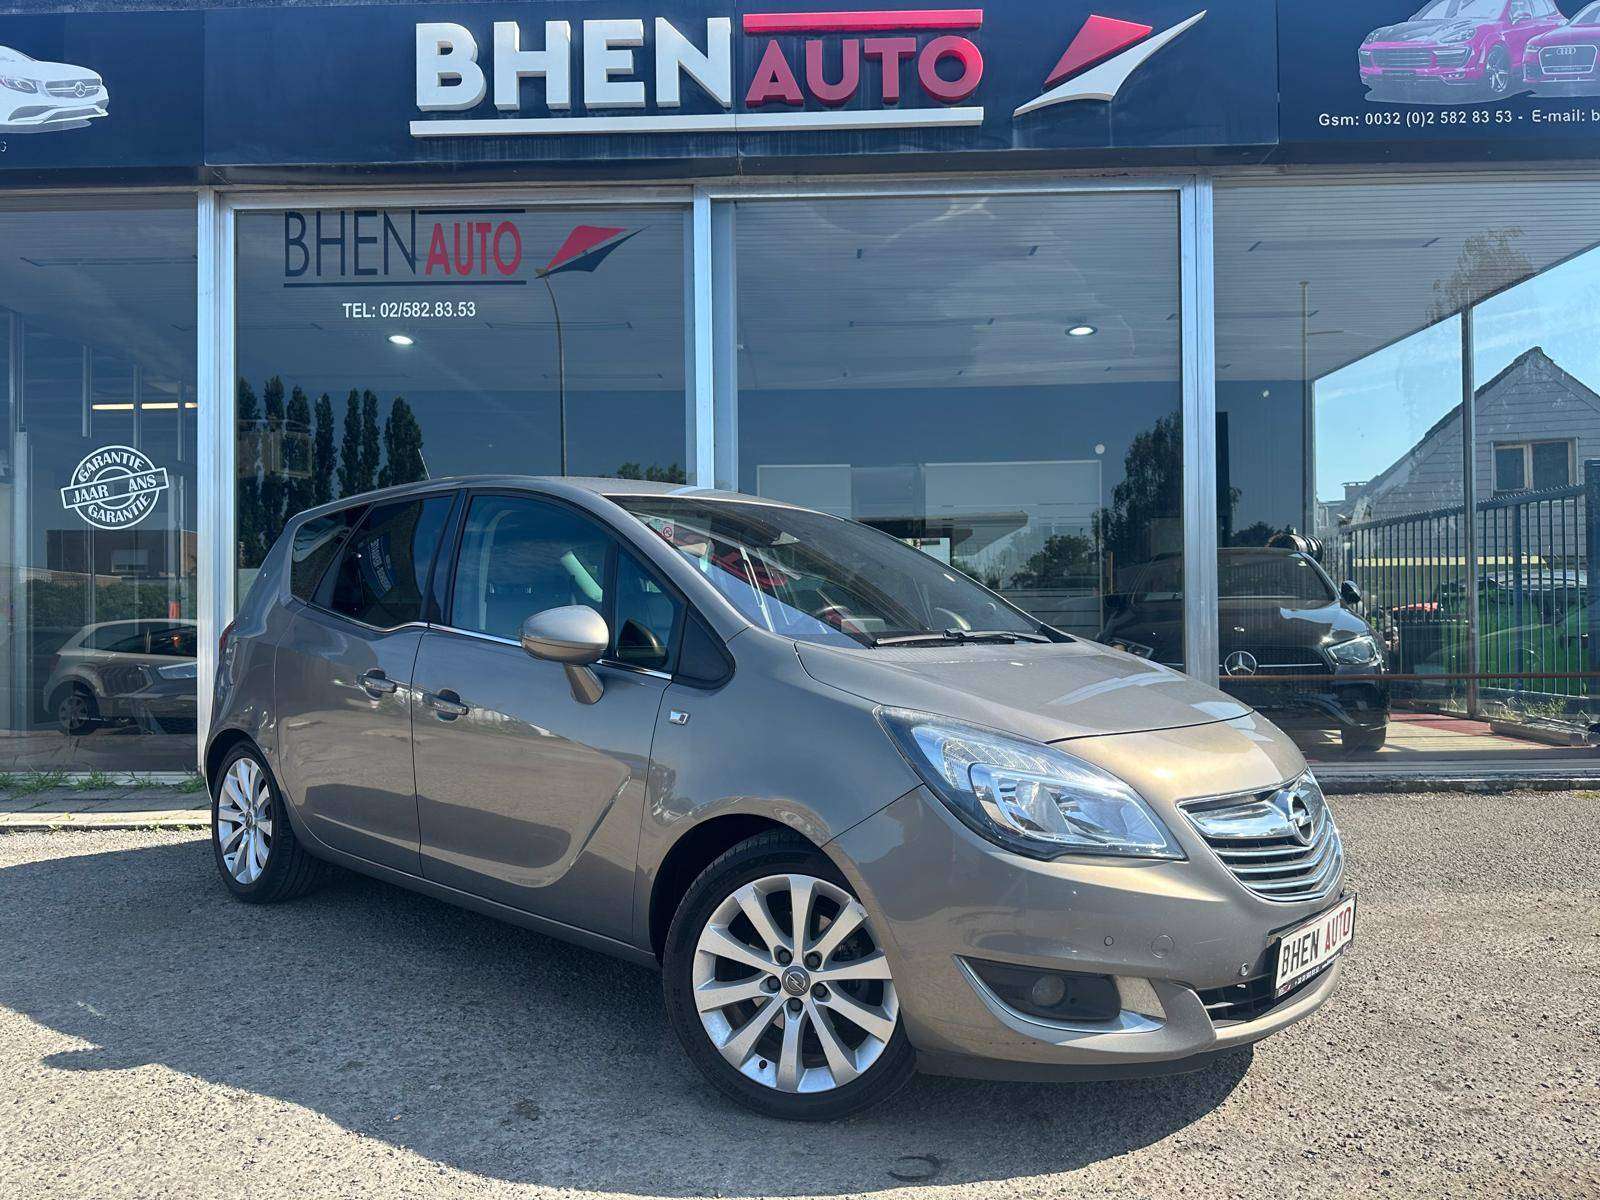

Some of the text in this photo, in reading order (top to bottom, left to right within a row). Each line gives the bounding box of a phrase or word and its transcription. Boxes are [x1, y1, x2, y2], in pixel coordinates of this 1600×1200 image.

[415, 16, 984, 112] BHEN AUTO
[1318, 113, 1359, 126] Gsm:
[1365, 113, 1400, 125] 0032
[1406, 112, 1434, 127] (0)2
[1440, 112, 1466, 124] 582
[1472, 111, 1489, 123] 83
[1495, 111, 1513, 123] 53
[1531, 109, 1585, 123] E-mail:
[284, 209, 522, 277] BHEN AUTO
[342, 302, 476, 318] TEL: 02/582.83.53
[78, 451, 144, 482] GARANTIE
[73, 474, 157, 503] JAAR ANS
[88, 494, 151, 523] GARANTIE
[1281, 929, 1320, 978] BHEN
[1325, 906, 1352, 953] AUTO
